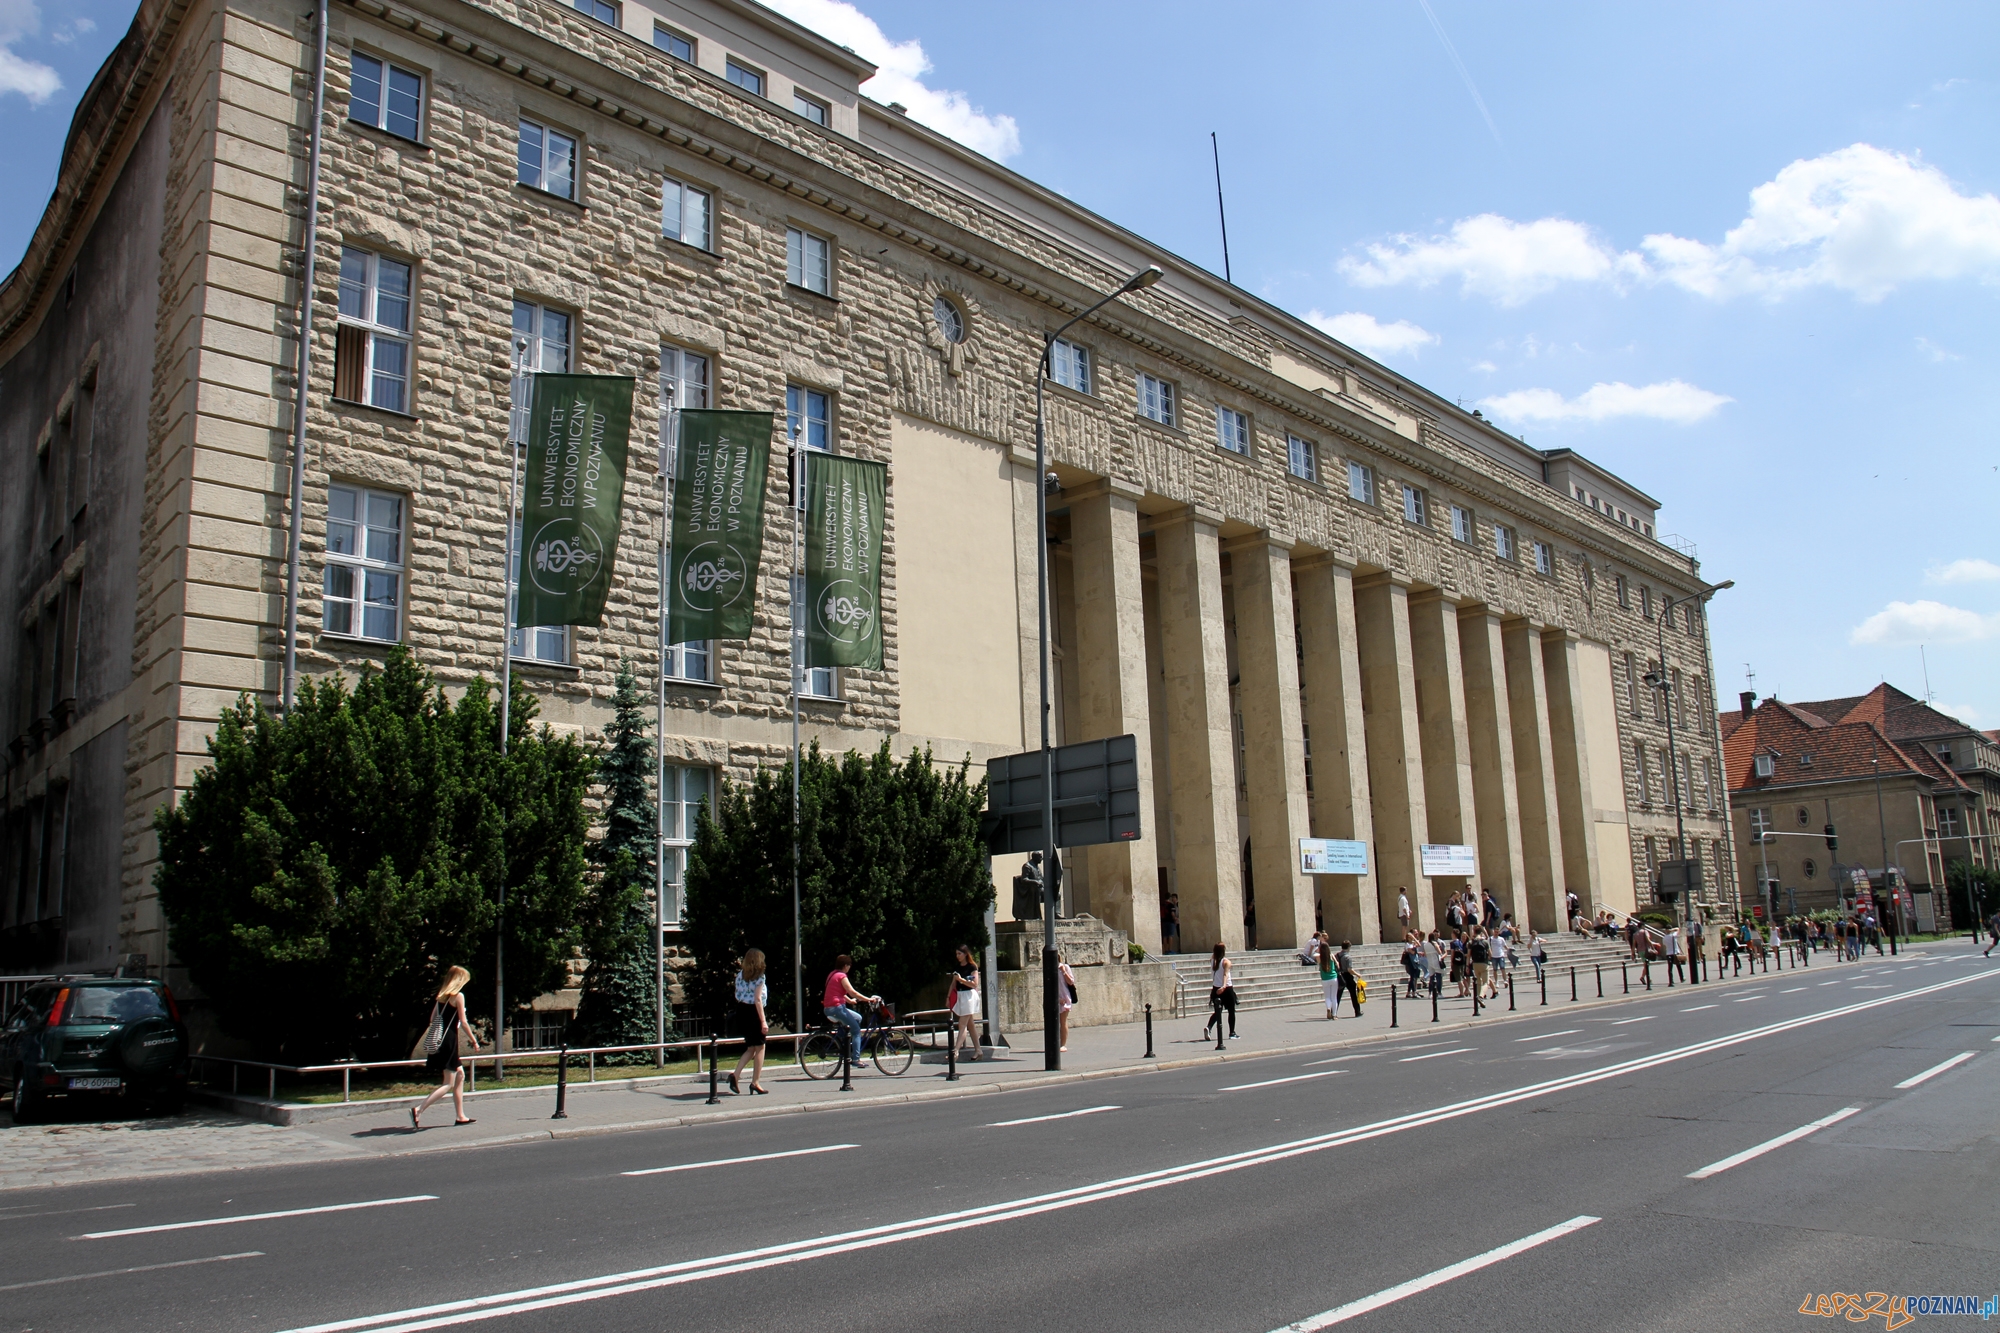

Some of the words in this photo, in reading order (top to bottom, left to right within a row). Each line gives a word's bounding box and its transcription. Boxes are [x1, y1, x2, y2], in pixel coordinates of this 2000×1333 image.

[540, 406, 565, 508] UNIWERSYTET
[560, 400, 586, 507] EKONOMICZNY
[584, 412, 606, 491] POZNANIU
[707, 435, 730, 532] EKONOMICZNY
[728, 446, 748, 514] POZNANIU
[689, 441, 711, 534] UNIWERSYTET
[583, 494, 597, 509] W
[727, 518, 740, 532] W
[825, 483, 837, 569] UNIWERSYTET
[842, 479, 854, 572] EKONOMICZNY
[858, 492, 869, 558] POZNANIU
[571, 536, 580, 547] 26
[717, 557, 725, 567] 26
[859, 562, 869, 575] W
[569, 566, 578, 577] 19
[716, 584, 723, 594] 19
[853, 596, 859, 606] 26
[852, 621, 860, 630] 19
[143, 1037, 178, 1047] HONDA
[74, 1079, 88, 1087] PO
[91, 1078, 119, 1087] 609HS
